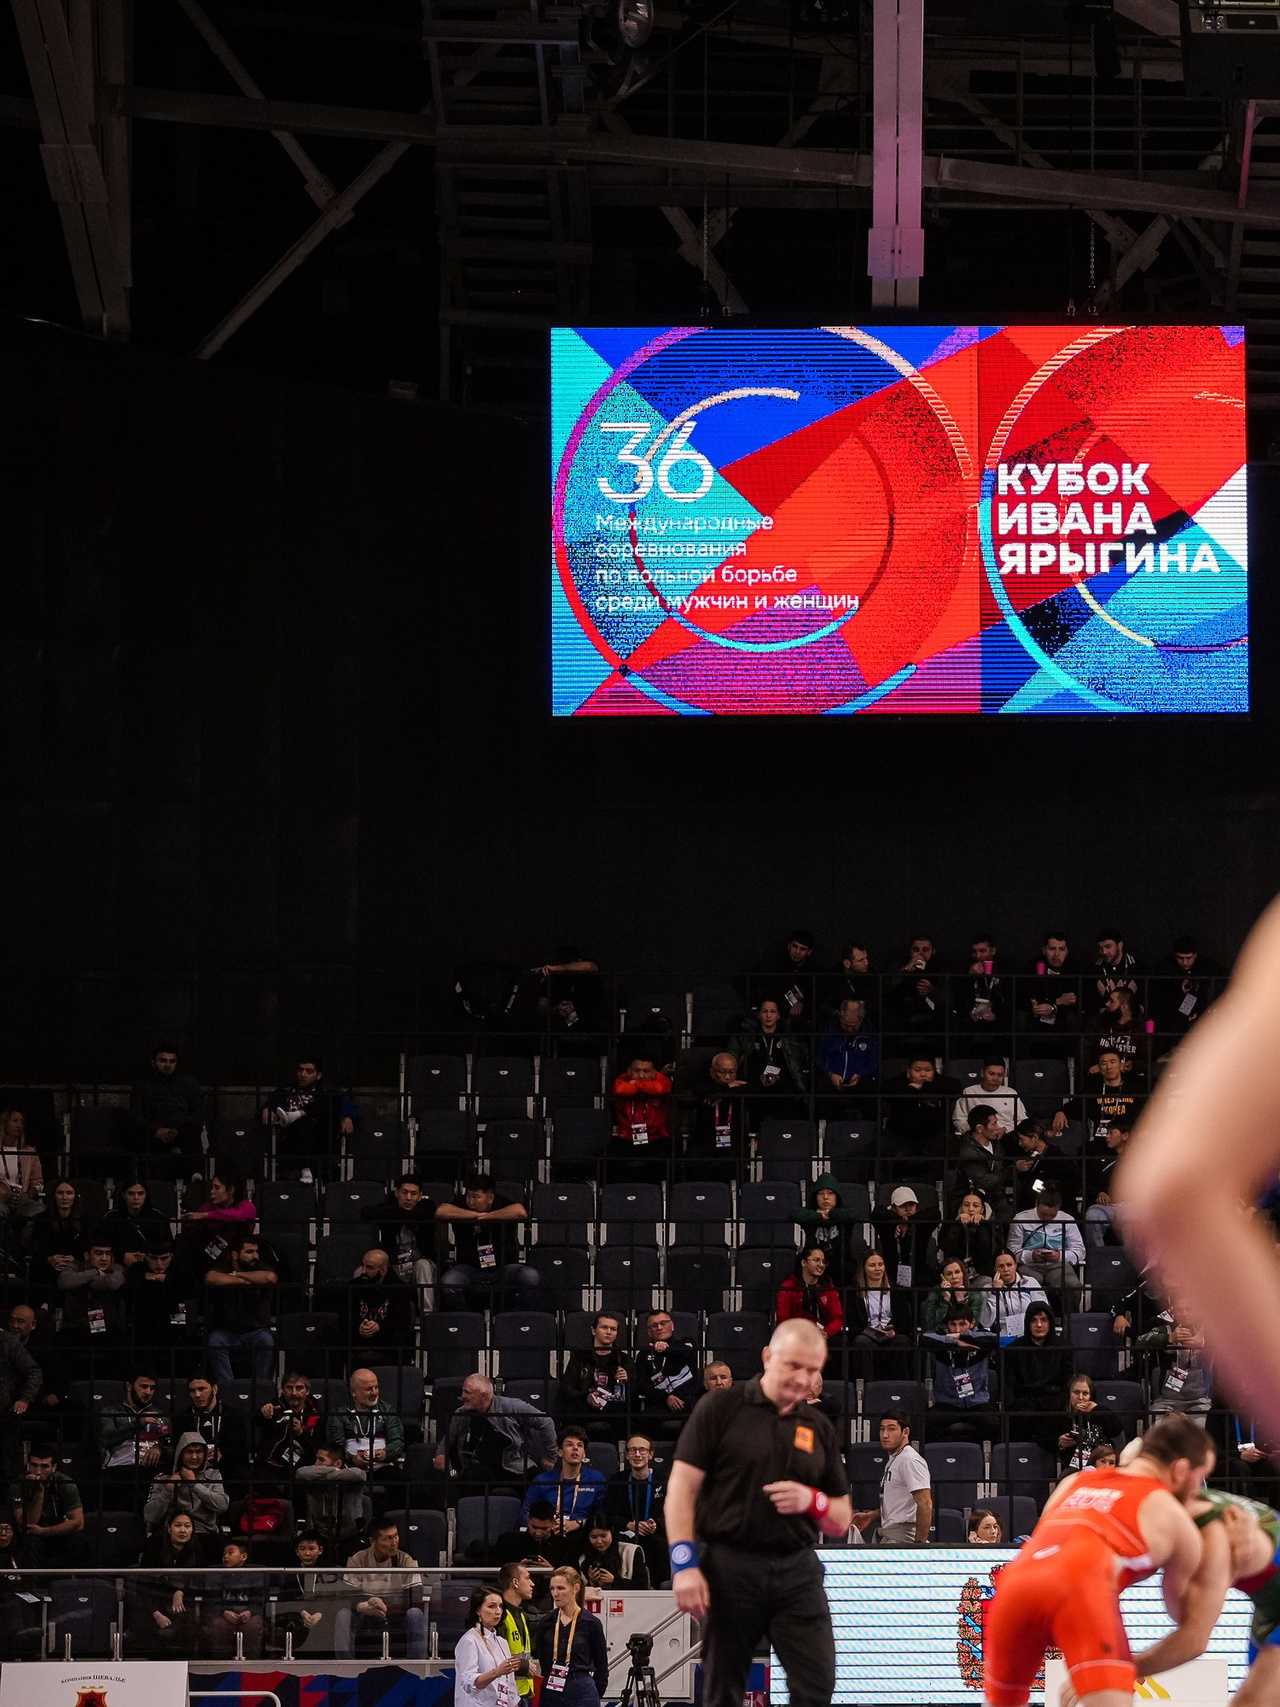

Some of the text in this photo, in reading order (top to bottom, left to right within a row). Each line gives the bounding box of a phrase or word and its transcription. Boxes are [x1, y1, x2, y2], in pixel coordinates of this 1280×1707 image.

[597, 421, 714, 503] 36
[998, 462, 1150, 495] КУБОК
[596, 514, 774, 535] Международные
[998, 502, 1157, 535] ИВАНА
[596, 542, 747, 558] соревнования
[999, 542, 1221, 574] ЯРЫГИНА
[596, 565, 797, 586] по вольной борьбе
[596, 594, 859, 613] среди мужчин и женщин
[1100, 1037, 1136, 1053] HOISTER
[511, 1630, 520, 1641] 15
